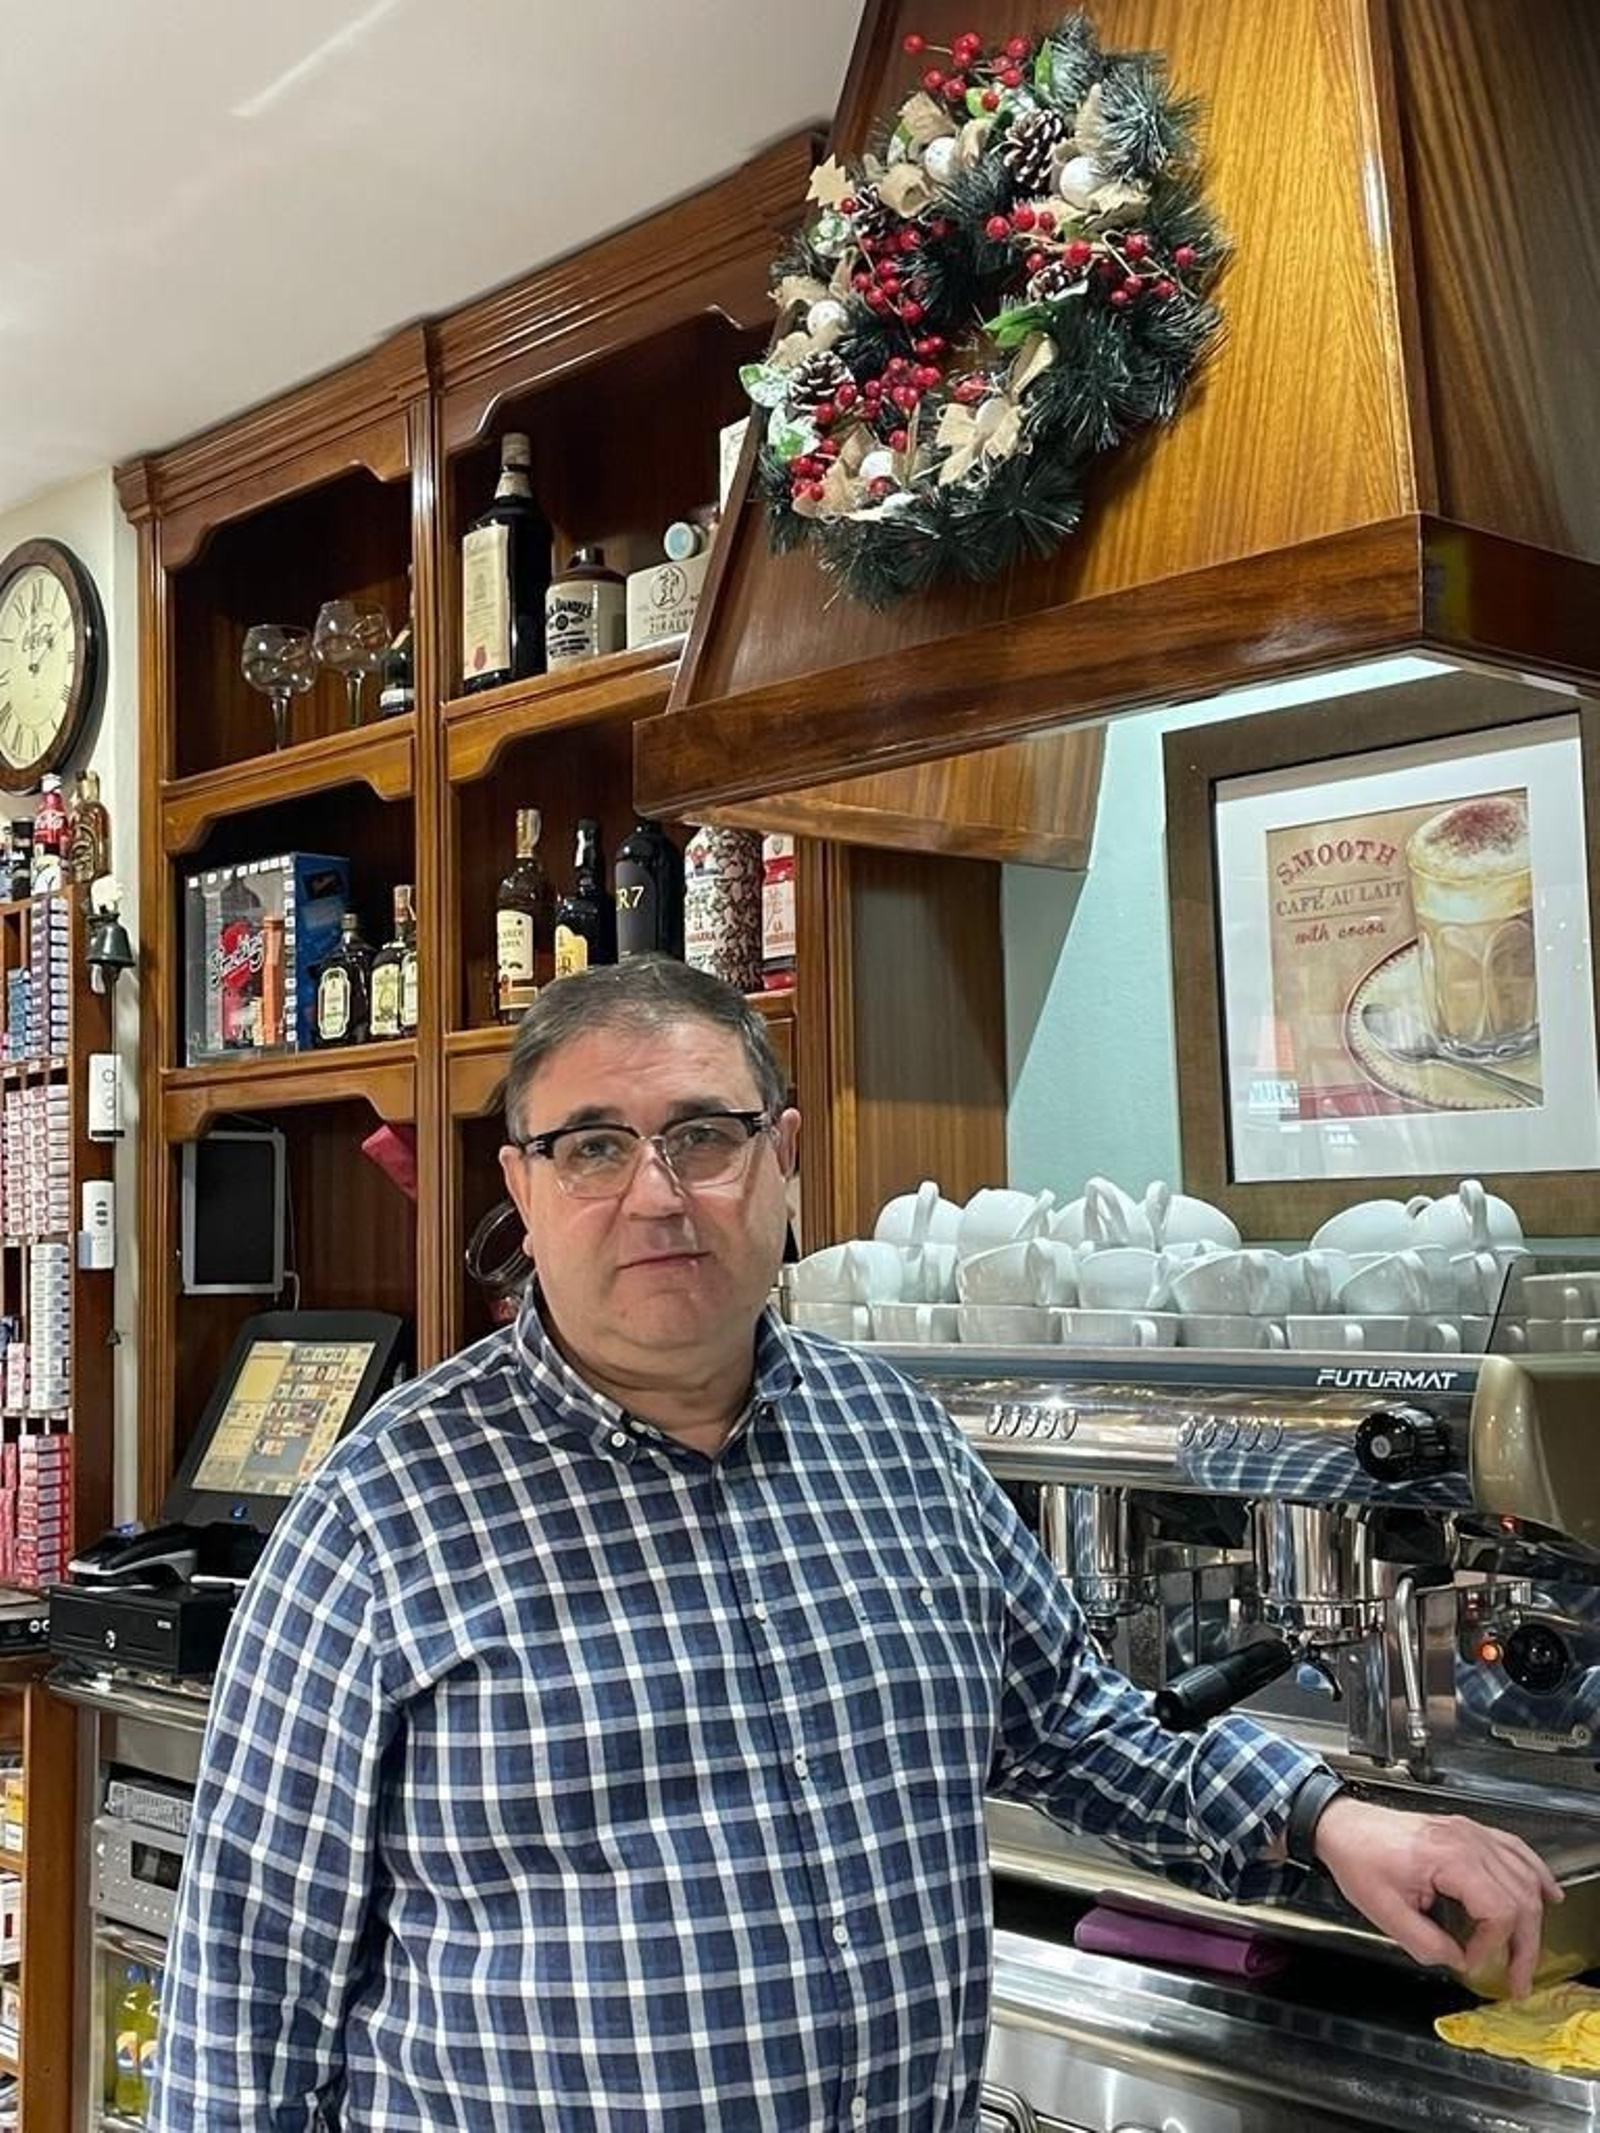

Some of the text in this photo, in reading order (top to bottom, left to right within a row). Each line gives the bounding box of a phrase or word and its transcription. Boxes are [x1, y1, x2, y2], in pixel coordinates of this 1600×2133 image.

[1276, 840, 1397, 885] SMOOTH
[1276, 880, 1405, 916] CAFÉ AU LAIT
[1295, 922, 1386, 944] with cocoa
[1316, 1369, 1458, 1390] FUTURMAT
